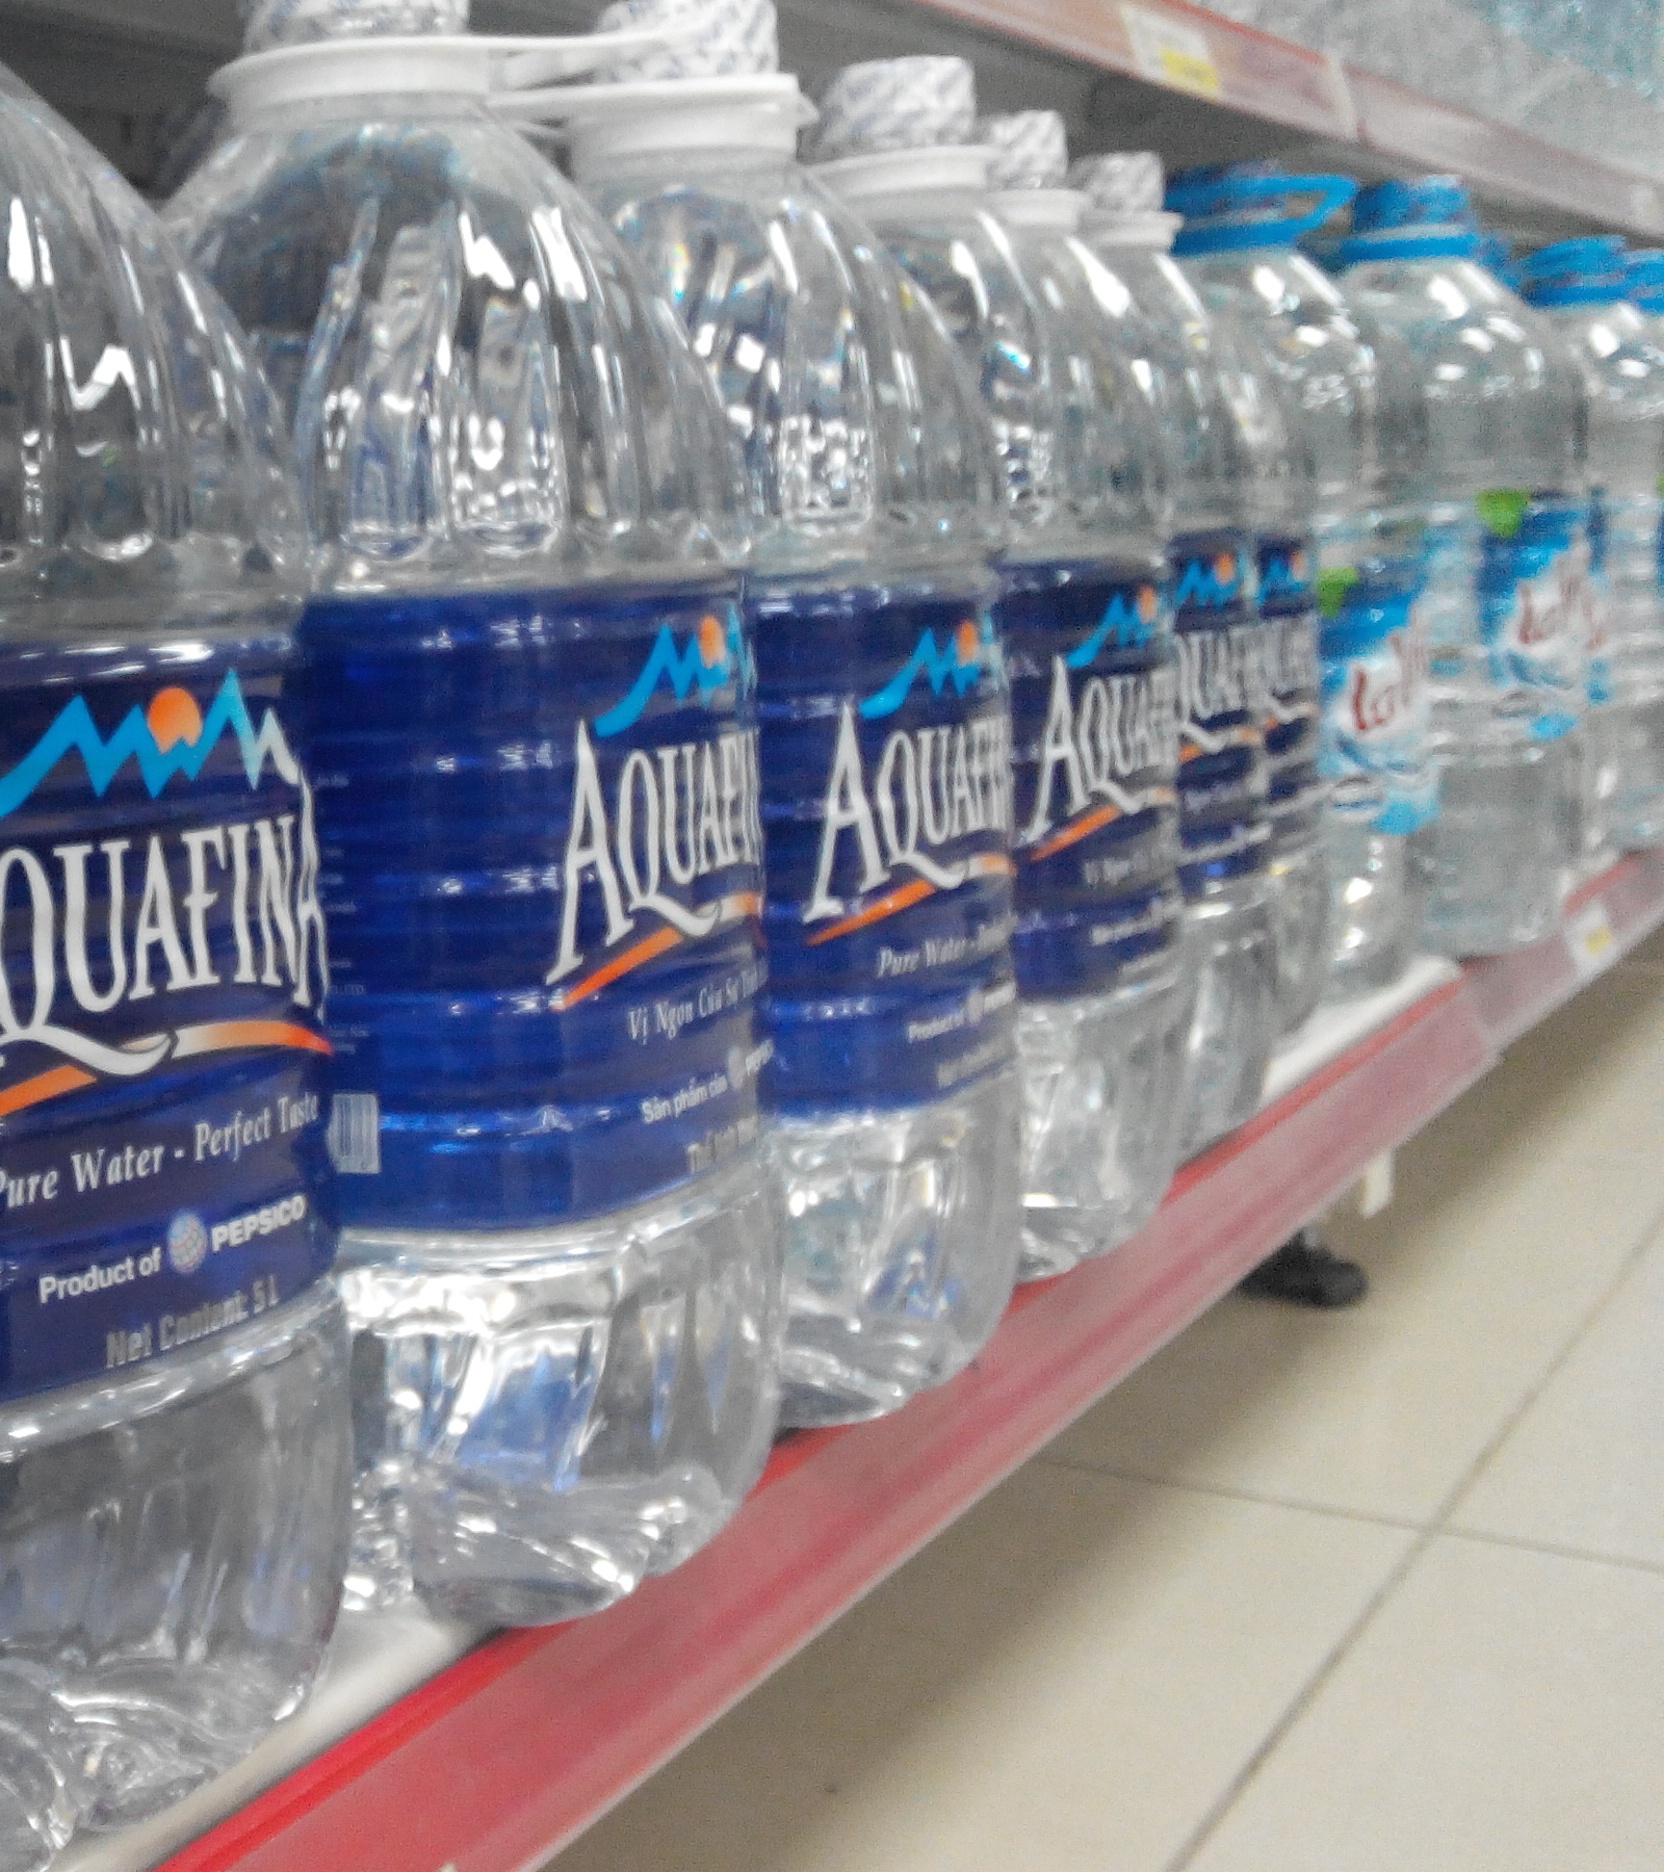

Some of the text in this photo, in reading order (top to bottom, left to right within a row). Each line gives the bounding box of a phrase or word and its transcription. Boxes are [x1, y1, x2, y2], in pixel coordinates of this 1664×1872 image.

[71, 1145, 164, 1192] Water
[195, 1107, 271, 1161] Perfect
[278, 1091, 318, 1133] Taste
[39, 1195, 306, 1303] Product of PEPSICO
